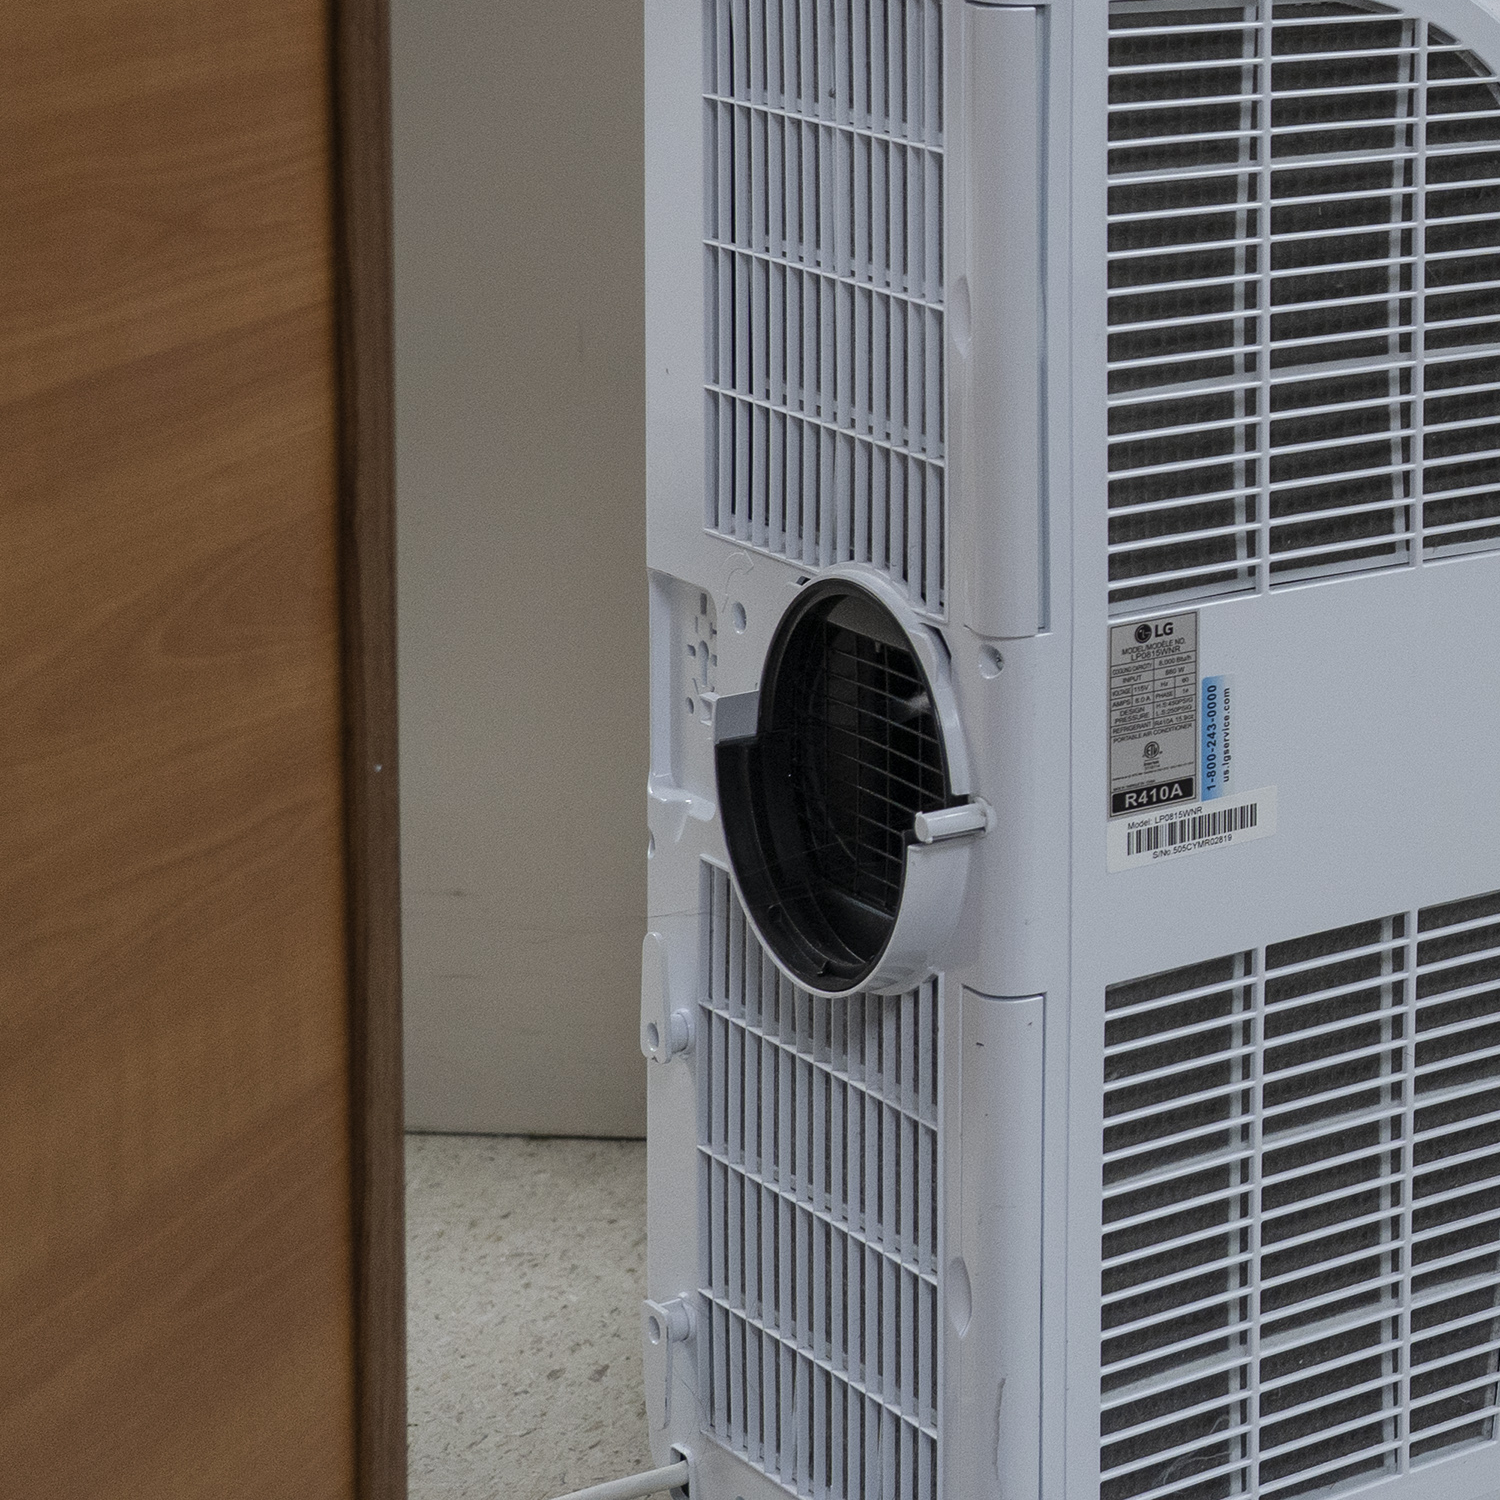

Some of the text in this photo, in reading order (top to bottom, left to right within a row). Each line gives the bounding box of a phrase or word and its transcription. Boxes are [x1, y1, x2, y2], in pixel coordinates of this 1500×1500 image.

[1154, 622, 1174, 638] LG
[1131, 645, 1181, 661] LP0815WNR
[1122, 674, 1142, 684] INPUT
[1112, 700, 1131, 708] AMPS
[1155, 691, 1173, 699] PHASE
[1114, 711, 1150, 724] PRESSURE
[1119, 706, 1145, 717] DESIGN
[1112, 721, 1152, 735] REFRIGERANT
[1113, 732, 1142, 744] PORTABLE
[1153, 722, 1193, 736] CONDITIONER
[1221, 687, 1231, 783] us.lgservice.com
[1206, 684, 1217, 791] 1-800-243-0000
[1125, 783, 1184, 808] R410A
[1127, 807, 1203, 830] Model: LP0815WNR
